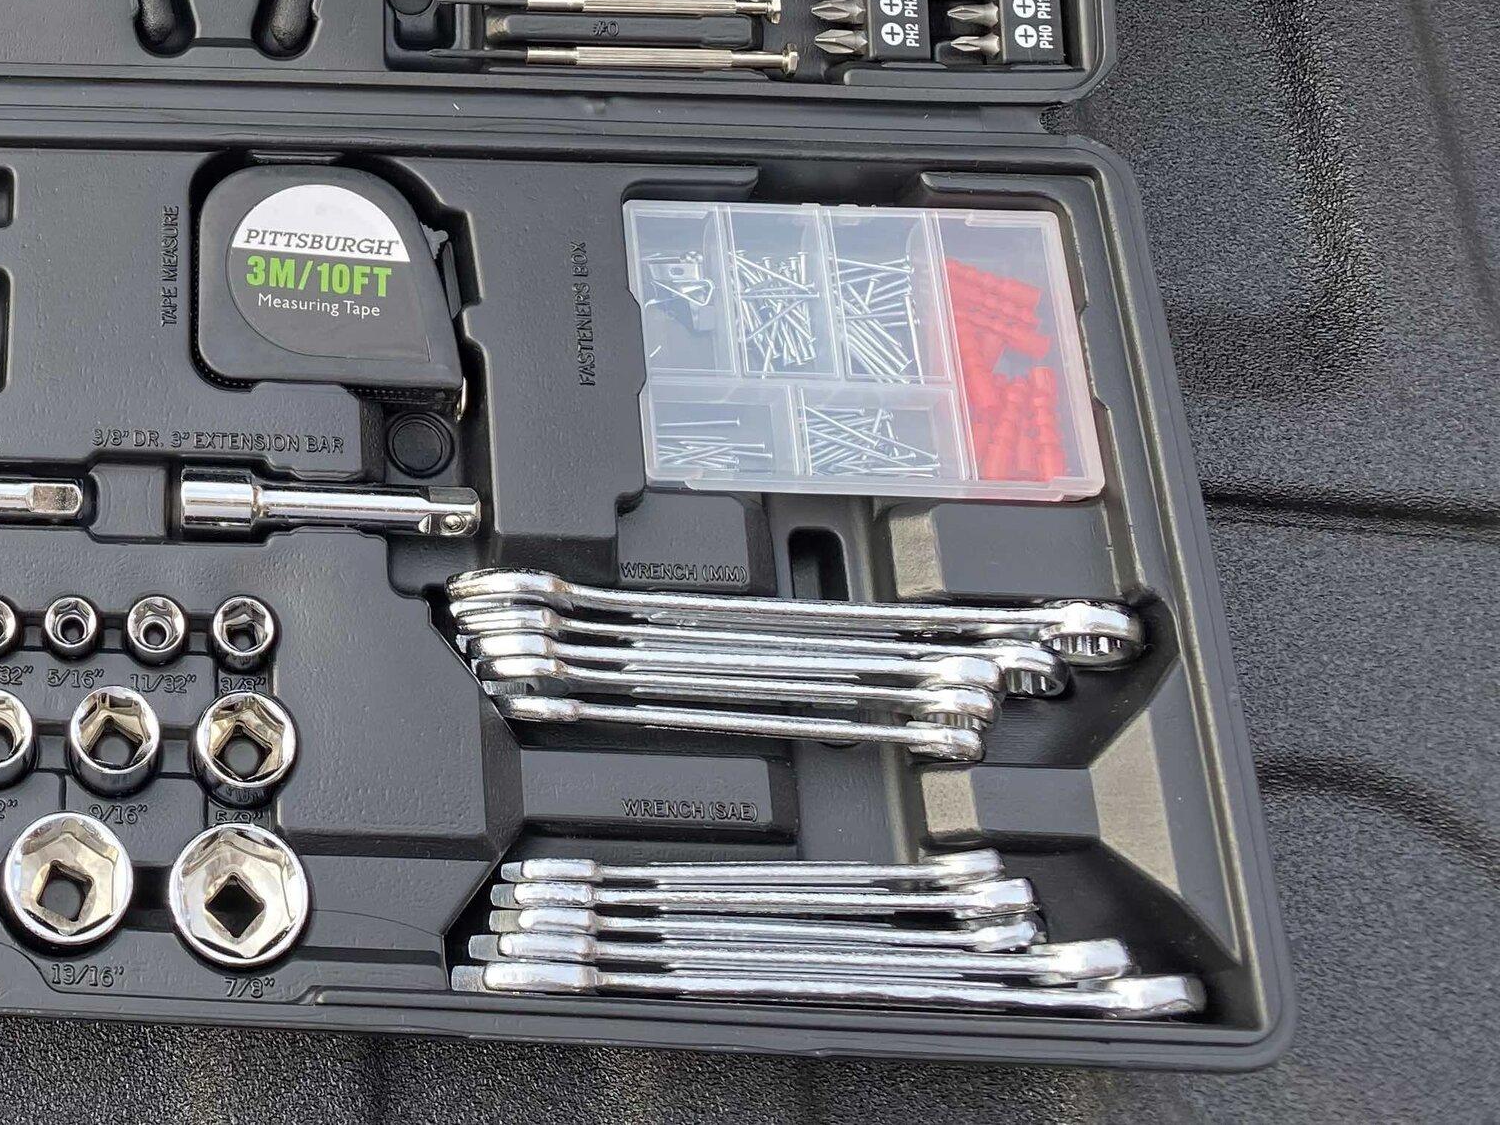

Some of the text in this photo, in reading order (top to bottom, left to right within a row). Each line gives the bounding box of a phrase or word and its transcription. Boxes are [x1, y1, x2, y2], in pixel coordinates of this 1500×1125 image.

[592, 21, 620, 37] #0
[905, 23, 920, 47] PH2
[1039, 24, 1054, 49] PH0
[244, 229, 395, 256] PITTSBURGH
[162, 205, 179, 327] TAPE MEASURE
[246, 255, 392, 297] 3M/10FT
[258, 292, 381, 320] Measuring Tape
[571, 241, 596, 387] FASTENERS BOX
[92, 429, 129, 447] 3/8"
[193, 432, 300, 453] EXTENSION
[305, 435, 345, 454] BAR
[620, 561, 748, 584] WRENCH (MM)
[47, 668, 105, 688] 5/16"
[130, 674, 197, 693] 11/32"
[621, 798, 759, 823] WRENCH (SAE)
[51, 963, 125, 988] 13/16"
[224, 976, 276, 999] 7/8"
